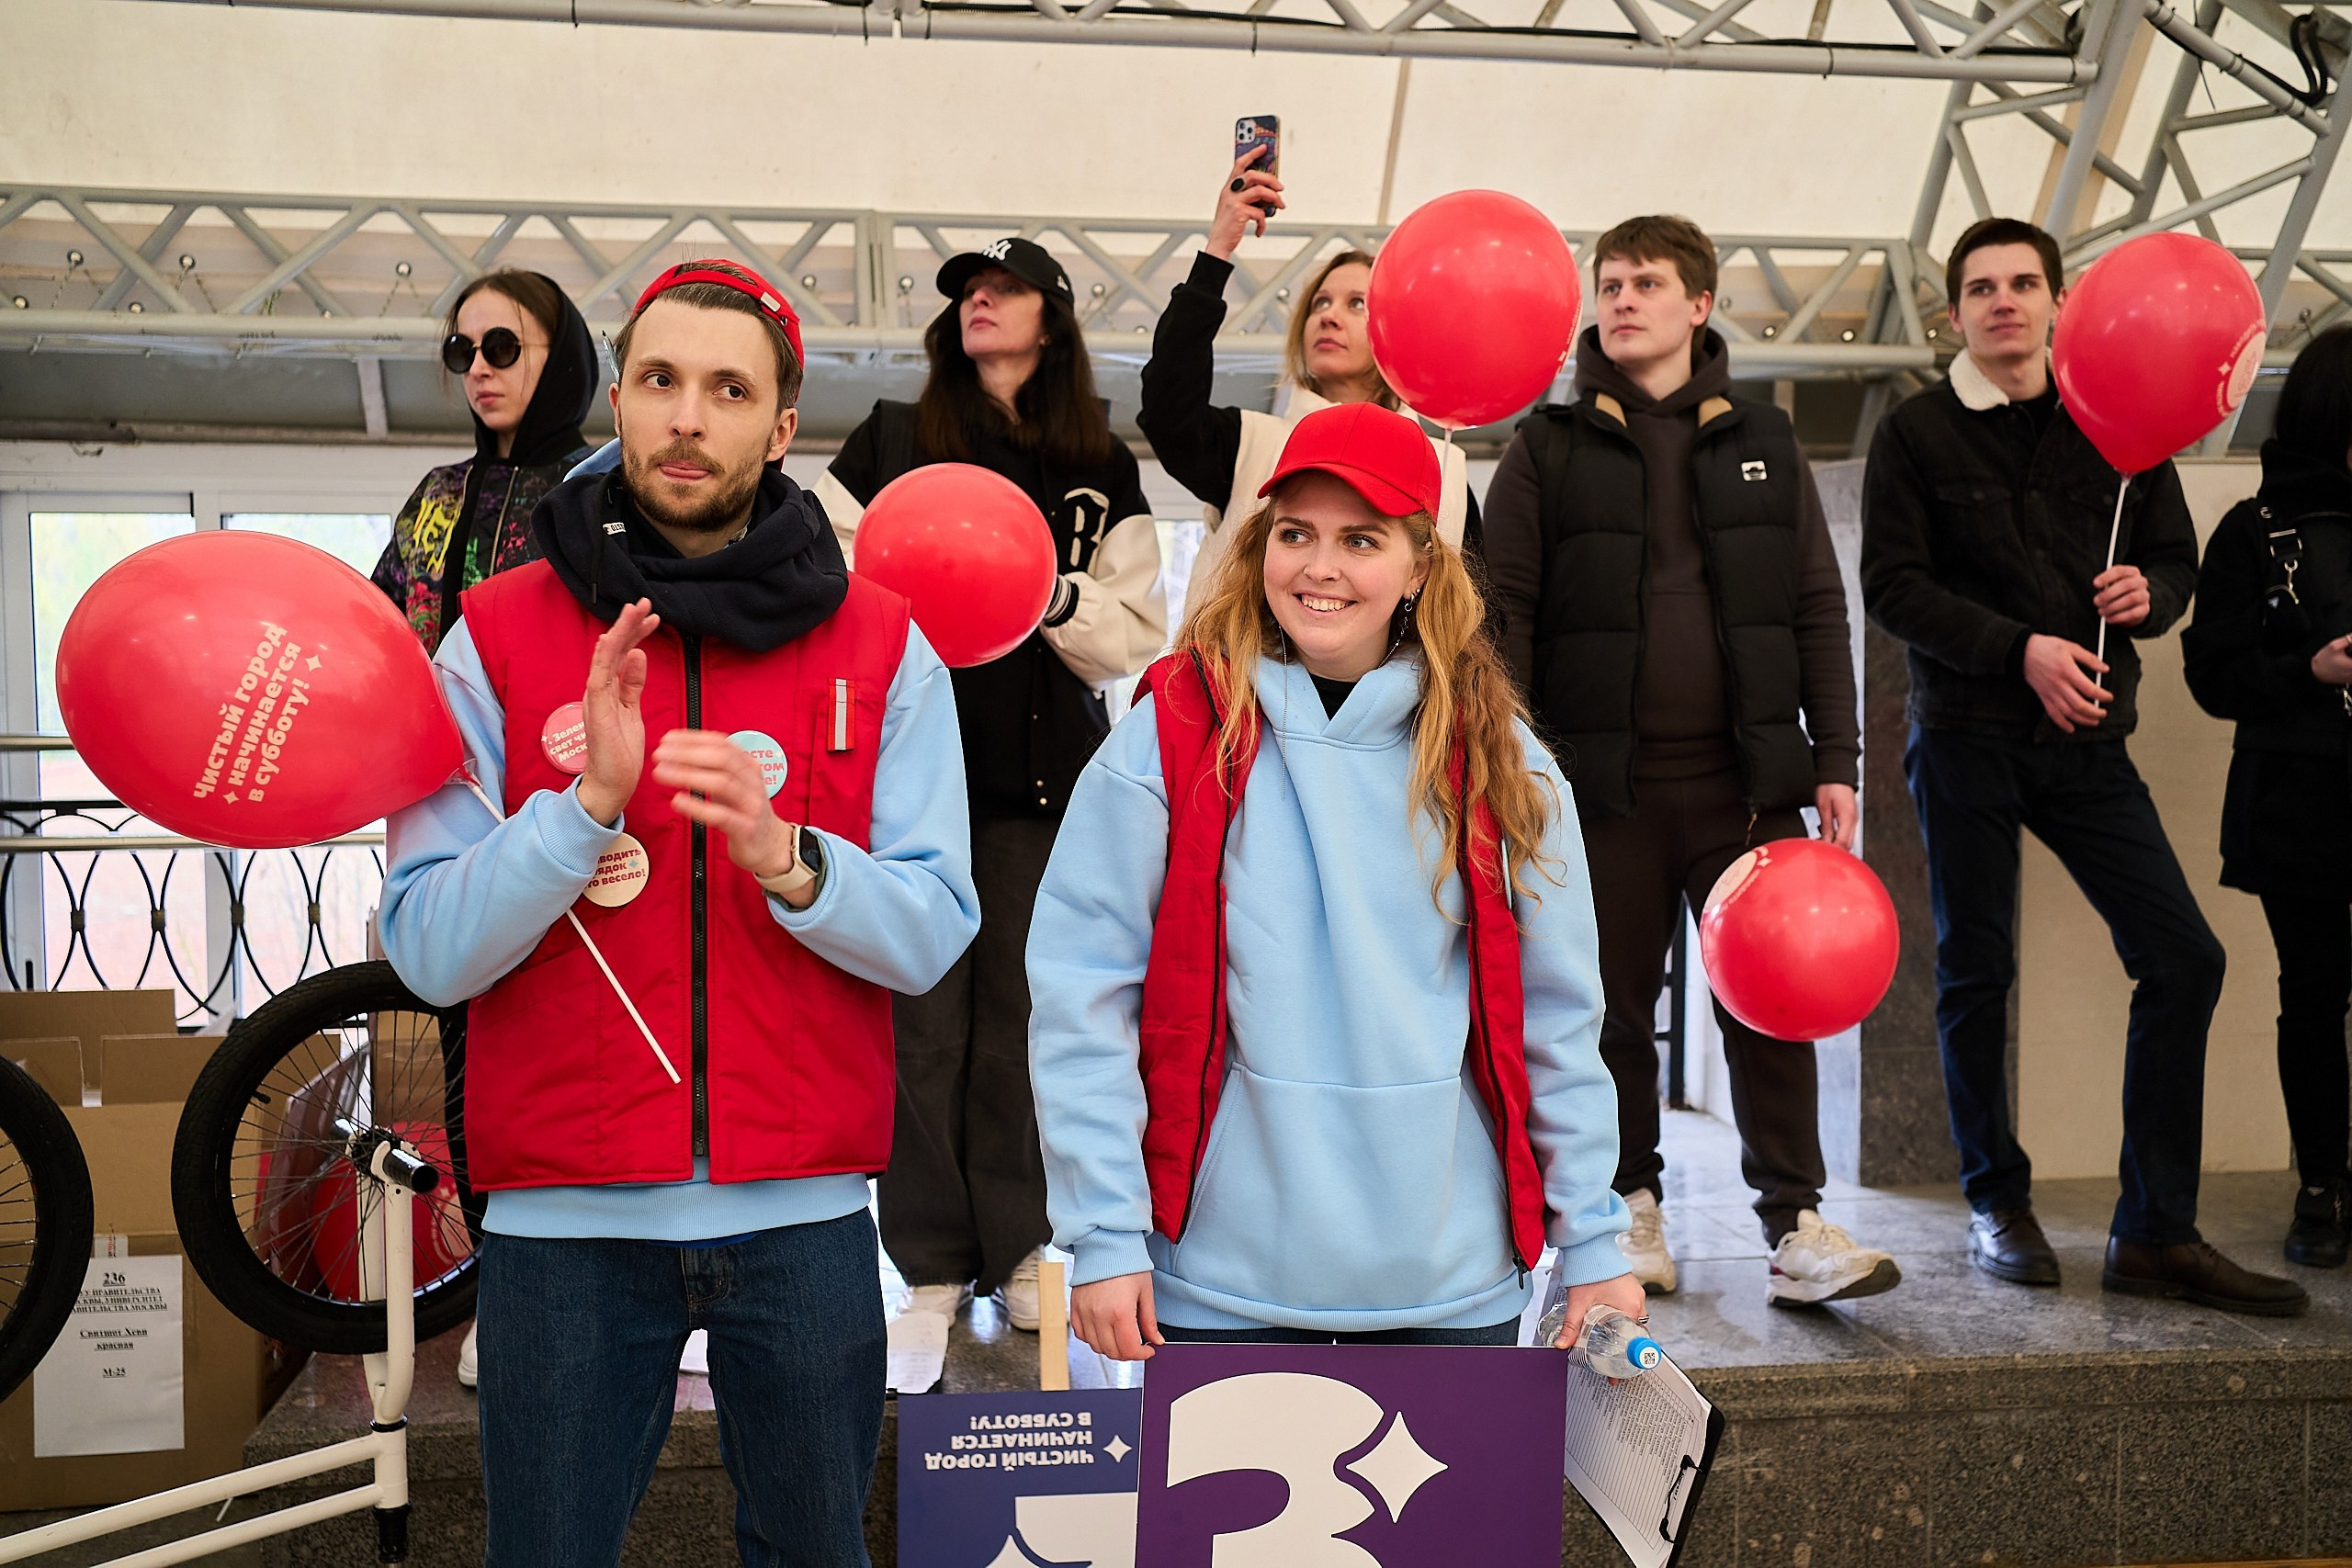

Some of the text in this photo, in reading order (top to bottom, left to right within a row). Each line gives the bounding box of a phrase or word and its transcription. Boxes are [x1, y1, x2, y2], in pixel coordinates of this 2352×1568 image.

[193, 625, 288, 799] Чистый город
[228, 642, 302, 786] начинается
[247, 678, 311, 803] в субботу!
[549, 739, 573, 755] свет
[597, 849, 641, 863] водить
[602, 868, 646, 886] весело!
[103, 1272, 126, 1286] 236
[970, 1412, 1092, 1431] В СУББОТУ!
[951, 1430, 1093, 1450] НАЧИНАЕТСЯ
[923, 1450, 1095, 1472] ЧИСТЫЙ ГОРОД
